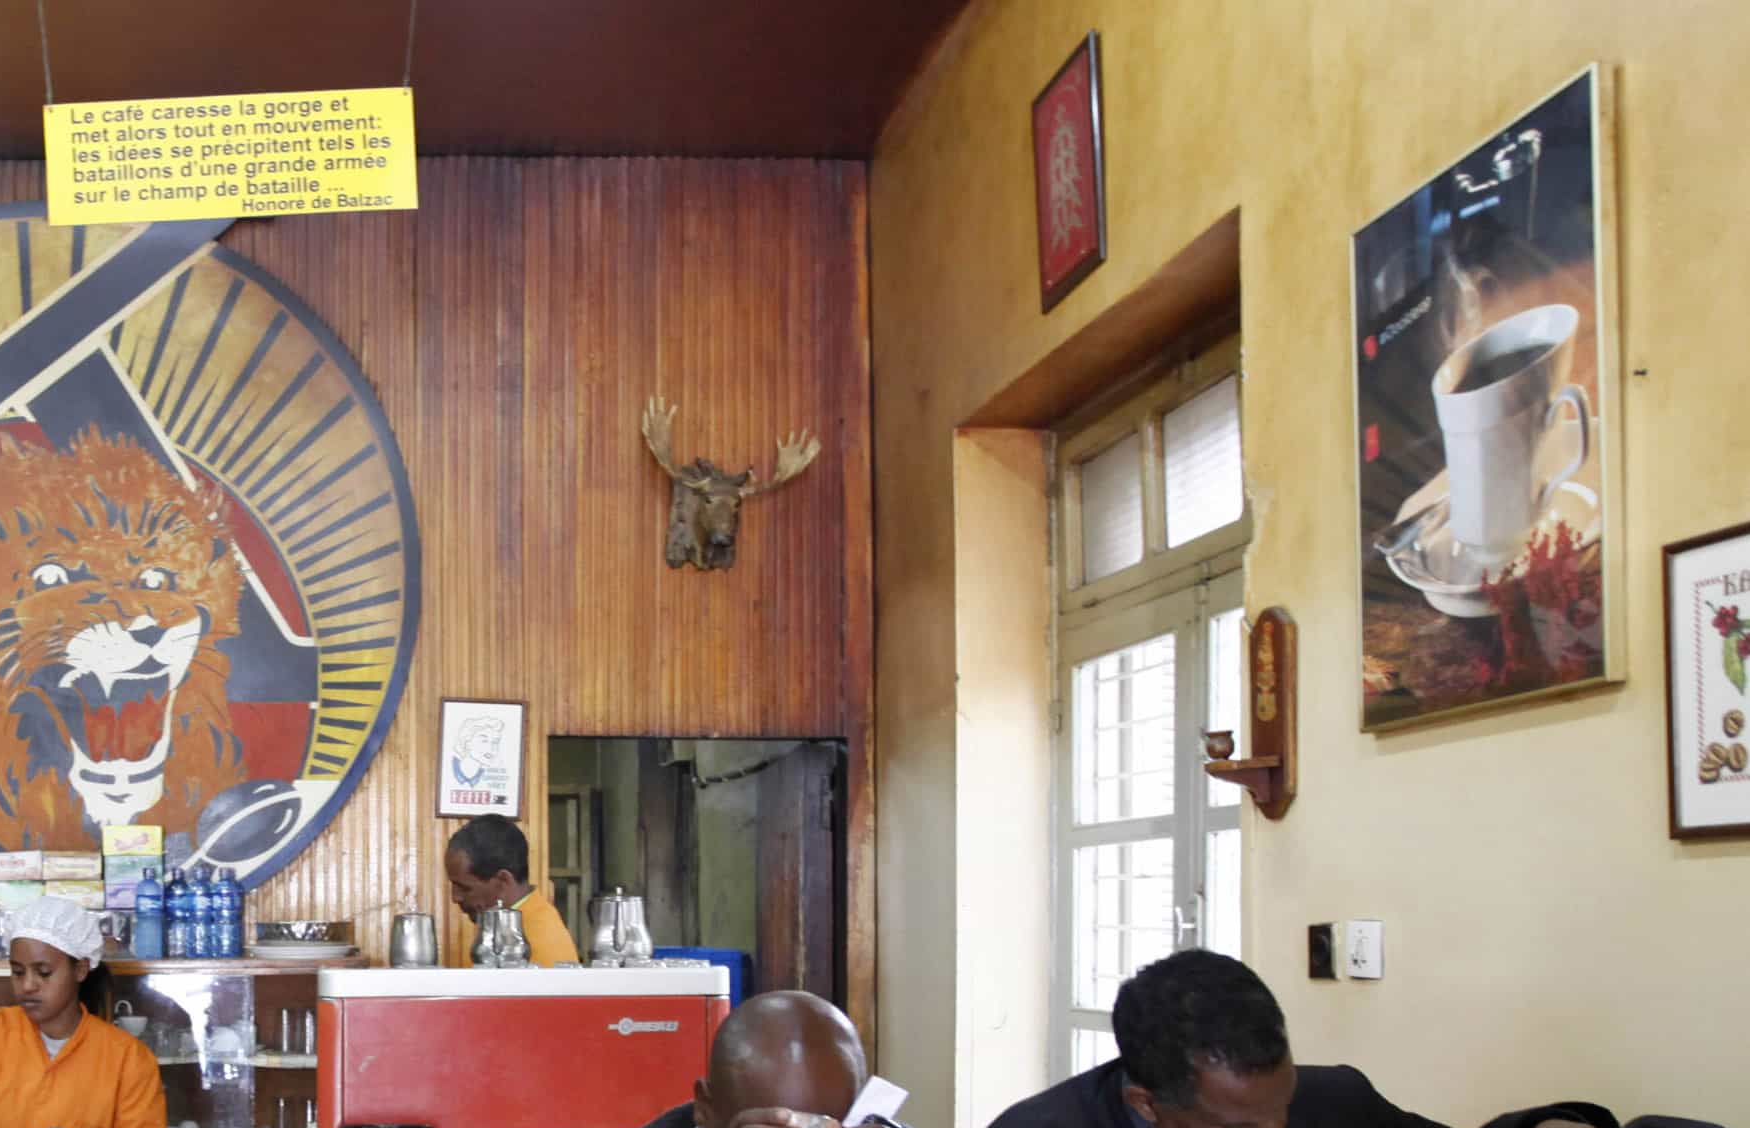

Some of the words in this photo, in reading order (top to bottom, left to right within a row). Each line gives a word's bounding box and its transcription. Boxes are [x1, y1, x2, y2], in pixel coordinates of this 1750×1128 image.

[70, 109, 94, 125] Le
[102, 105, 143, 123] café
[152, 104, 231, 121] caresse
[240, 100, 256, 116] la
[264, 100, 322, 119] gorge
[330, 97, 348, 112] et
[72, 128, 108, 144] met
[116, 125, 166, 142] alors
[174, 123, 214, 139] tout
[222, 123, 245, 136] en
[254, 115, 381, 134] mouvement:
[73, 148, 100, 163] les
[108, 144, 162, 162] idées
[171, 145, 193, 158] se
[202, 137, 311, 161] précipitent
[319, 135, 354, 152] tels
[363, 134, 391, 150] les
[74, 164, 172, 183] bataillons
[181, 161, 237, 177] d'une
[245, 156, 316, 179] grande
[324, 152, 386, 171] armée
[74, 190, 106, 205] sur
[114, 187, 130, 201] le
[138, 185, 207, 201] champ
[215, 180, 238, 197] de
[247, 177, 320, 195] bataille
[312, 196, 331, 208] de
[337, 193, 393, 208] Balzac
